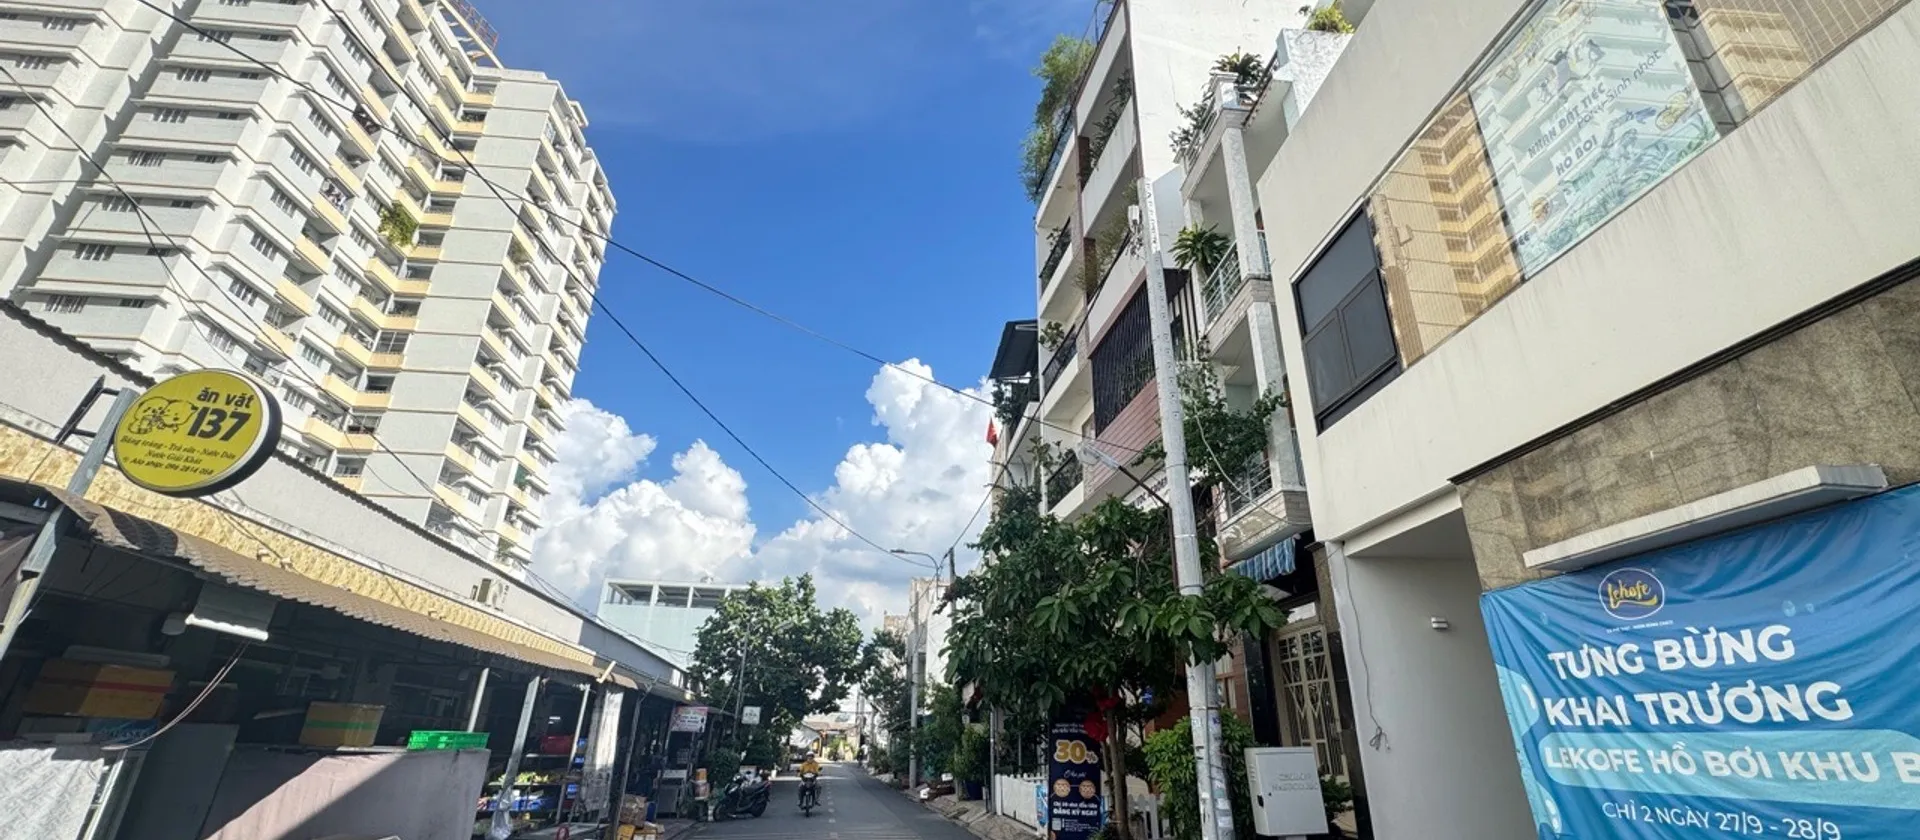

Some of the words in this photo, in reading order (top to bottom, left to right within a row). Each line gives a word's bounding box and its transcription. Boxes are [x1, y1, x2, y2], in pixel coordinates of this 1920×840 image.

[197, 387, 220, 403] ăn
[225, 392, 255, 410] vặt
[187, 406, 252, 441] 137
[1547, 643, 1646, 680] TƯNG
[1652, 624, 1796, 672] BỪNG
[1543, 695, 1632, 726] KHAI
[1634, 679, 1854, 726] TRƯƠNG
[1544, 747, 1643, 774] LEKOFE
[1649, 741, 1697, 776] HỒ
[1704, 746, 1773, 779] BƠI
[1777, 751, 1880, 782] KHU
[1641, 805, 1654, 823] 2
[1654, 805, 1710, 829] NGÀY
[1714, 811, 1764, 835] 27/9
[1782, 817, 1841, 840] 28/9
